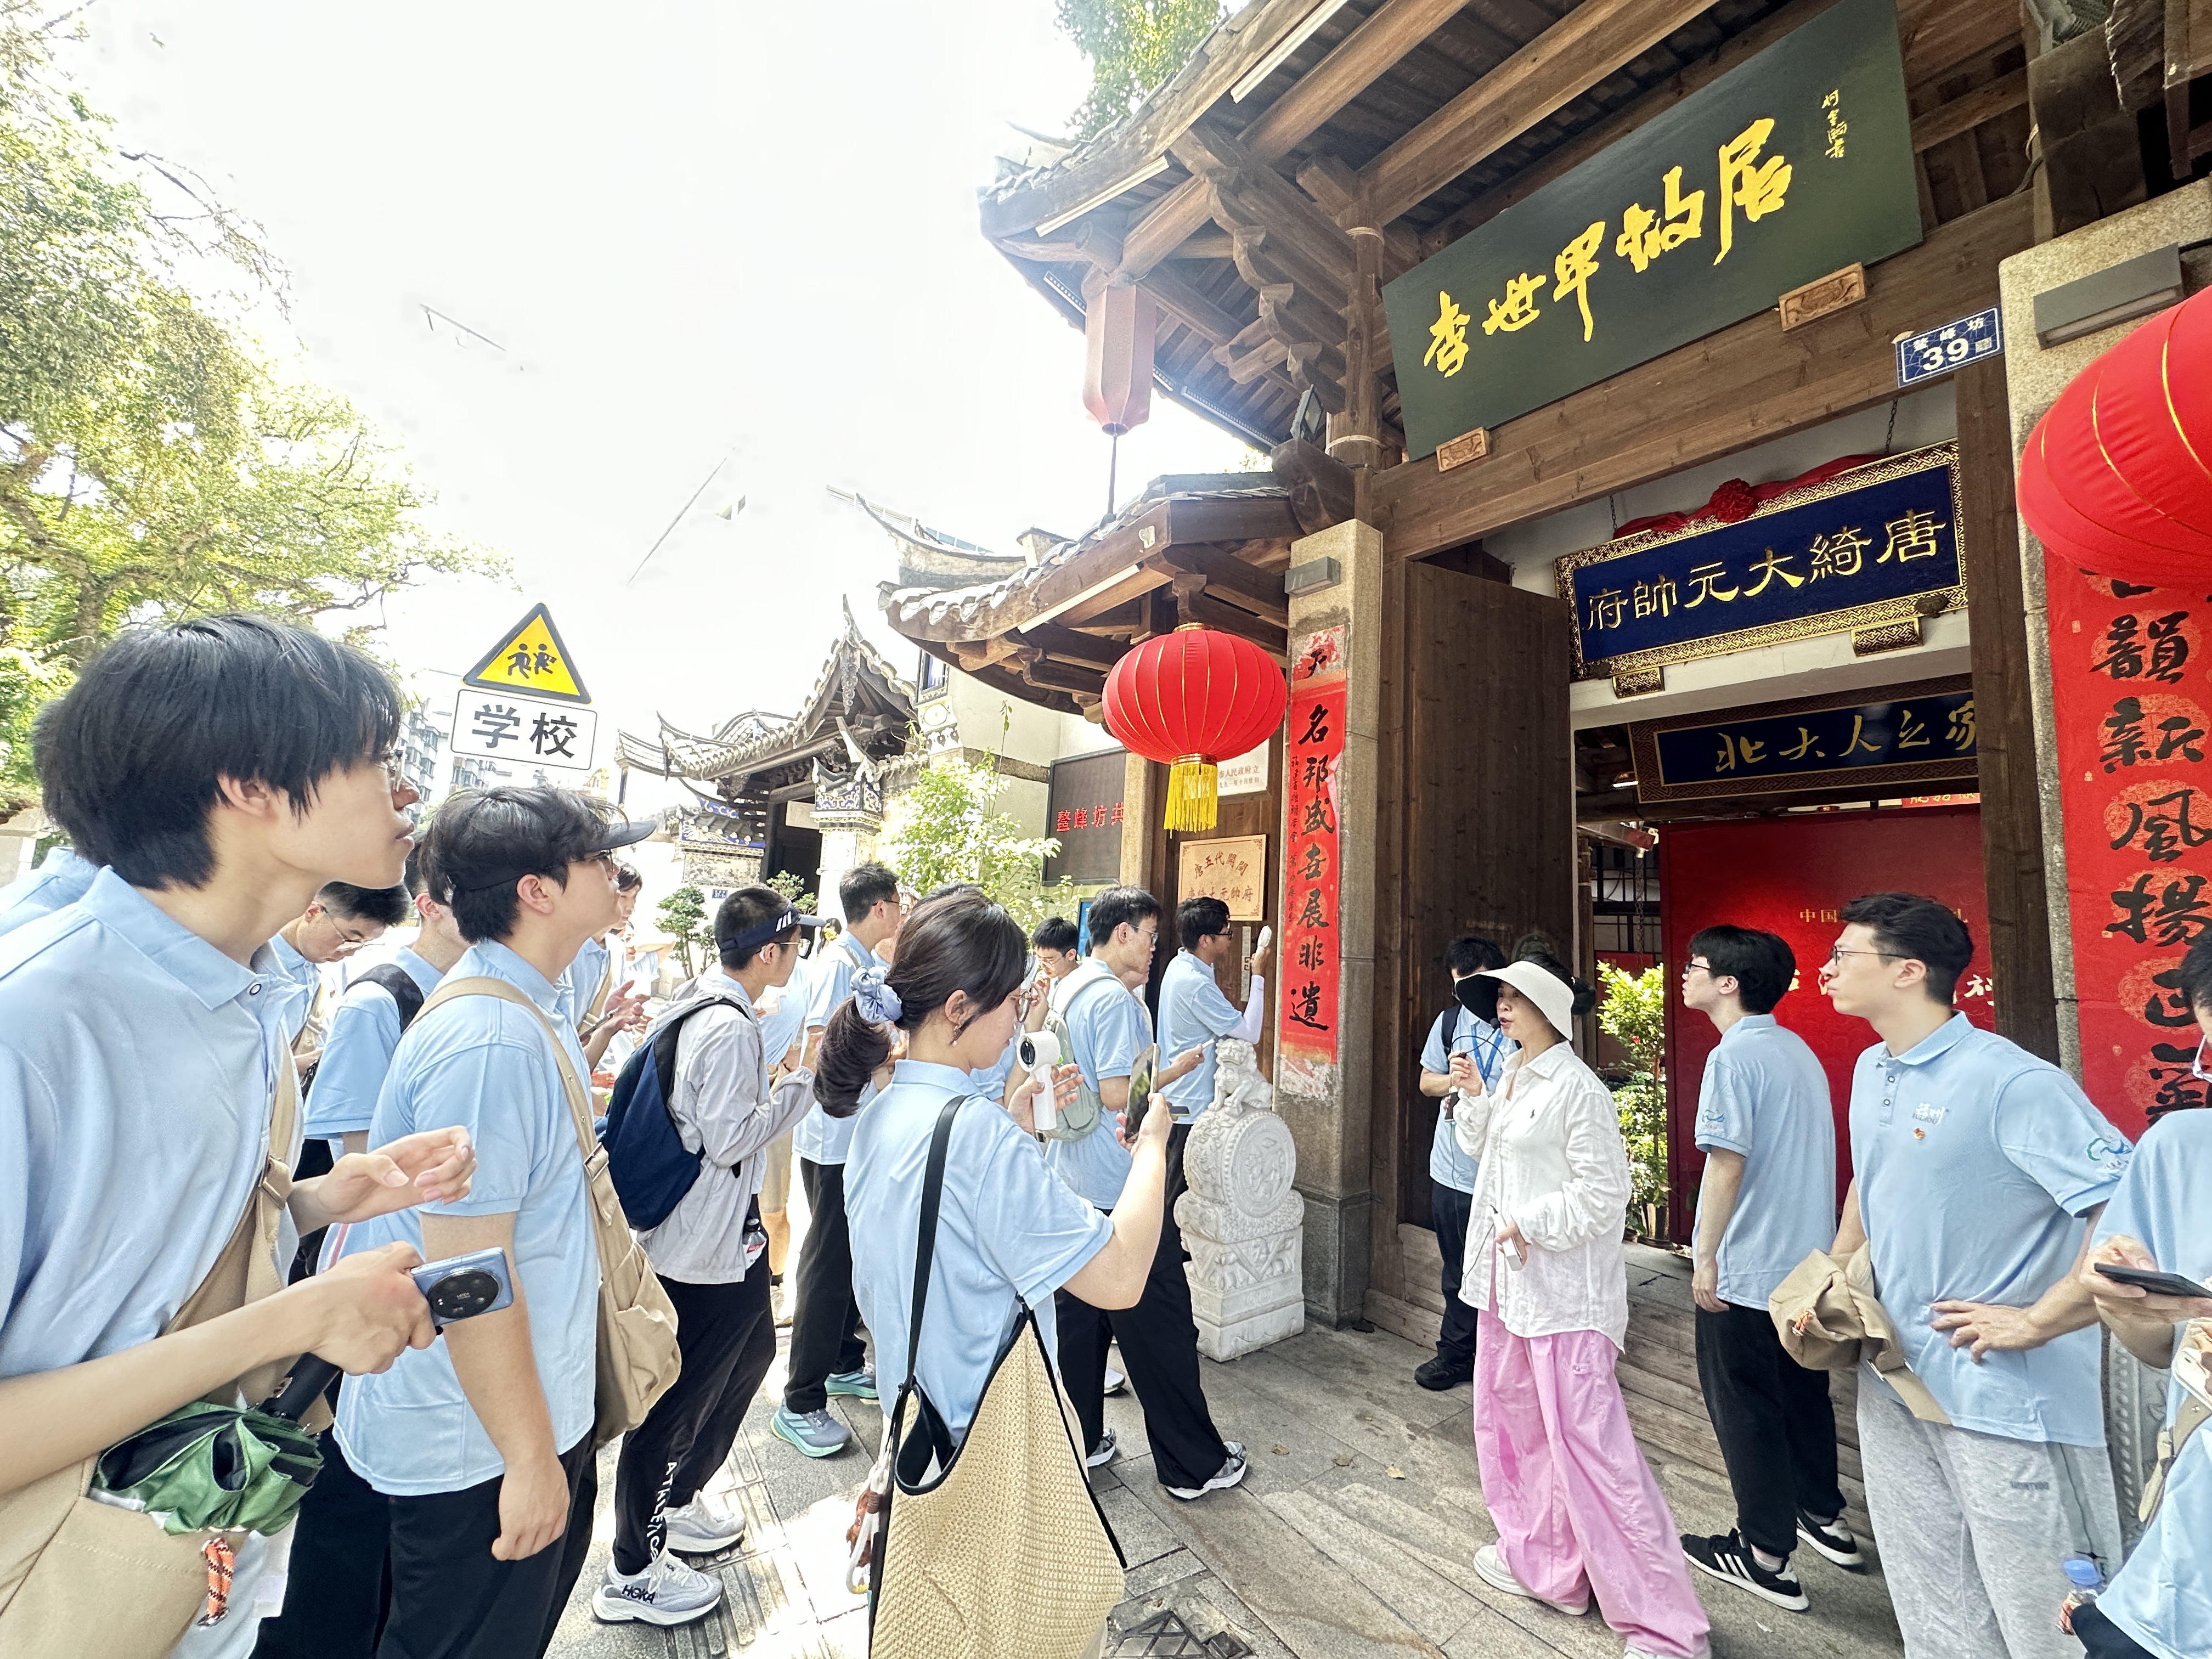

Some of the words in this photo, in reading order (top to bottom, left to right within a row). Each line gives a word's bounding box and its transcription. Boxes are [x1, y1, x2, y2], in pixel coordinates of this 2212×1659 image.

[1423, 116, 1793, 378] 李世甲故居
[1922, 338, 1969, 371] 39
[1587, 508, 1946, 631] 唐綺大元帥府
[472, 704, 578, 759] 学校
[1194, 851, 1249, 879] 唐五代開閩
[621, 1584, 656, 1605] HOKA
